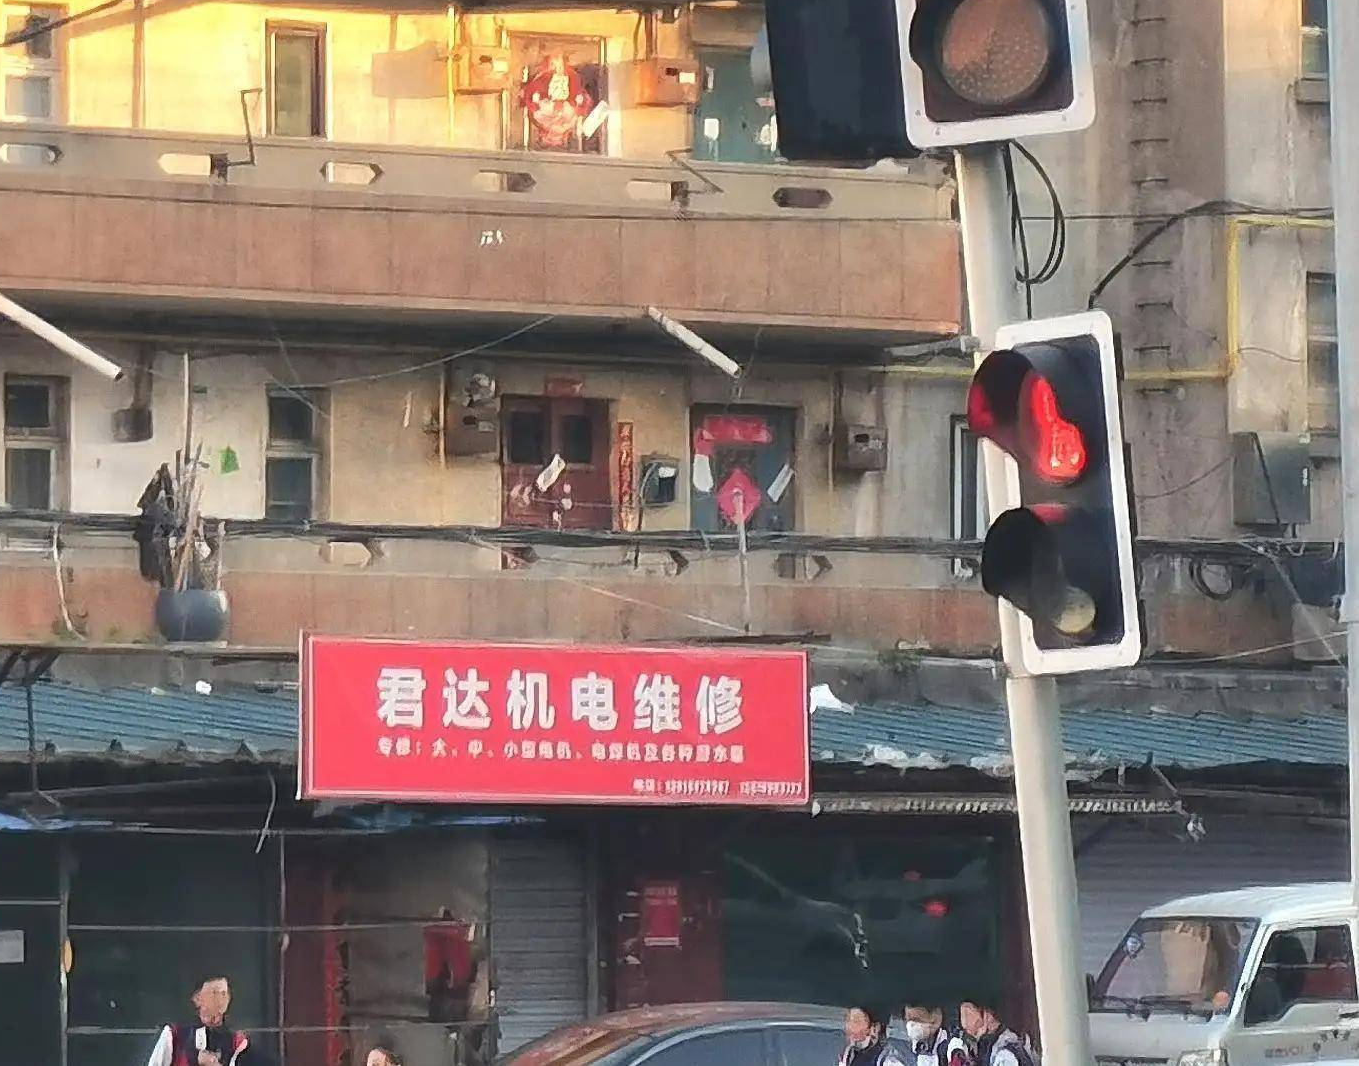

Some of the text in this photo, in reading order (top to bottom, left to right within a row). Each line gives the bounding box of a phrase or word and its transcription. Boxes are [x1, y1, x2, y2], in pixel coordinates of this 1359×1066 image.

[375, 667, 743, 734] 君达机电维修
